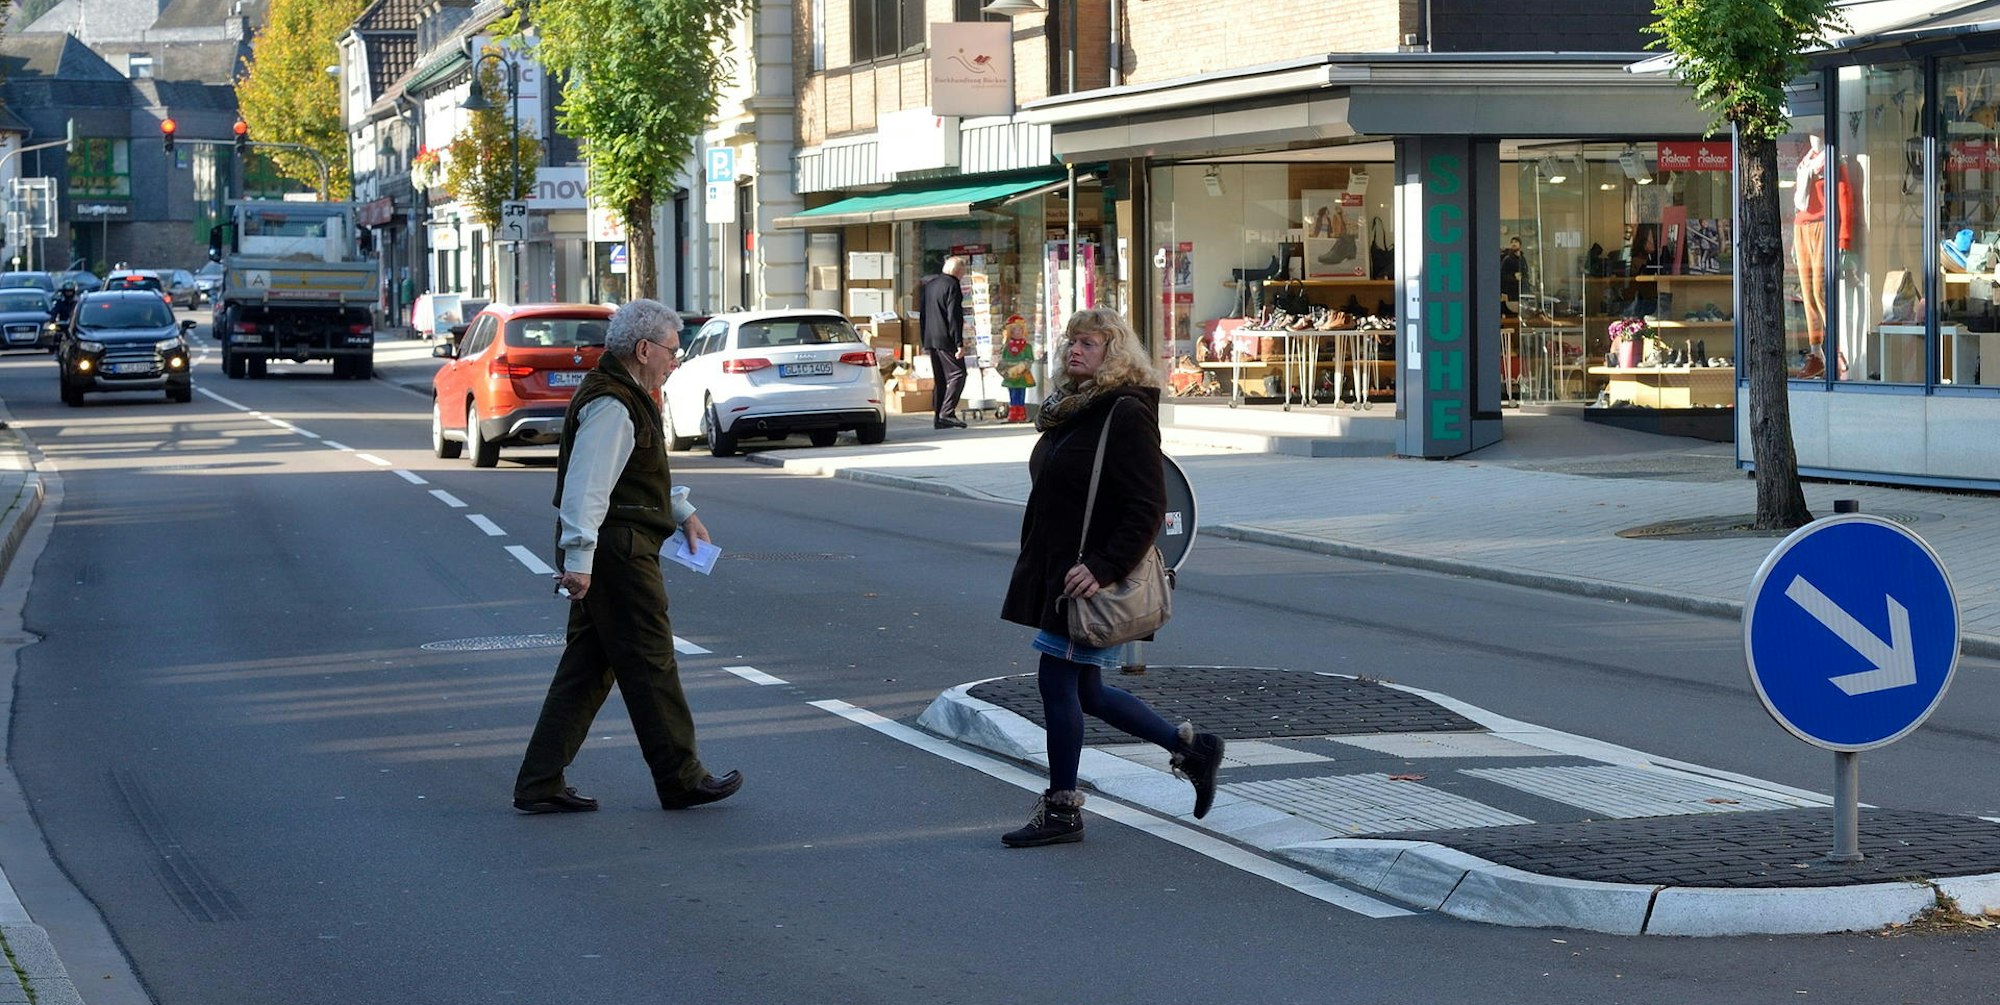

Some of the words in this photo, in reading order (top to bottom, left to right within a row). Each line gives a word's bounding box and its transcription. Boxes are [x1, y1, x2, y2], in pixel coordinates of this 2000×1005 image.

[1661, 153, 1691, 163] rieker
[1697, 153, 1728, 163] rieker
[712, 151, 728, 180] P
[252, 273, 265, 286] A
[1427, 154, 1464, 441] SCHUHE
